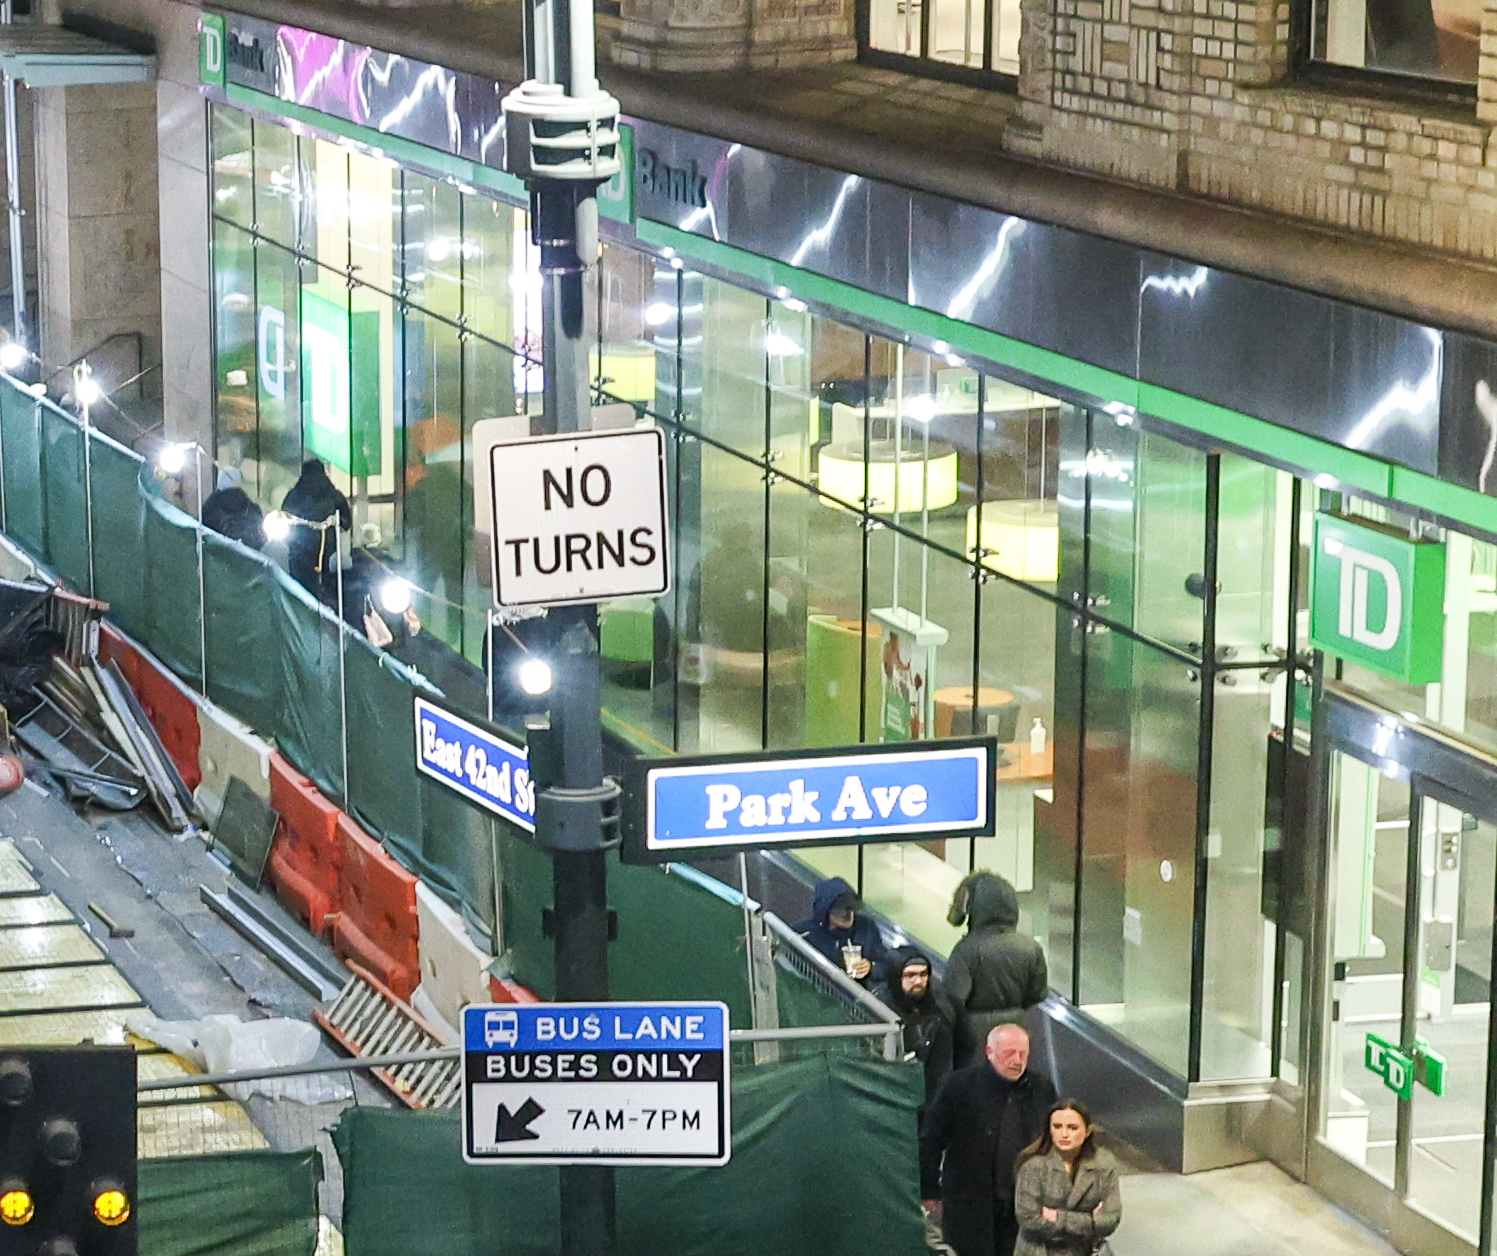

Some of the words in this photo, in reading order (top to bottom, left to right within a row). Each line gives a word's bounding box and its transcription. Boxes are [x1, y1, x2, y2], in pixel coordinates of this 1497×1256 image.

[227, 30, 265, 73] Bank
[637, 147, 708, 209] Bank
[542, 463, 612, 511] NO
[504, 526, 657, 578] TURNS
[1322, 537, 1403, 652] TD
[420, 718, 463, 780] East
[463, 734, 512, 807] 42nd
[705, 777, 821, 830] Park
[831, 774, 928, 822] Ave
[536, 1015, 602, 1041] BUS
[614, 1015, 705, 1041] LANE
[486, 1054, 599, 1079] BUSES
[611, 1053, 702, 1079] ONLY
[567, 1108, 701, 1131] 7AM-7PM
